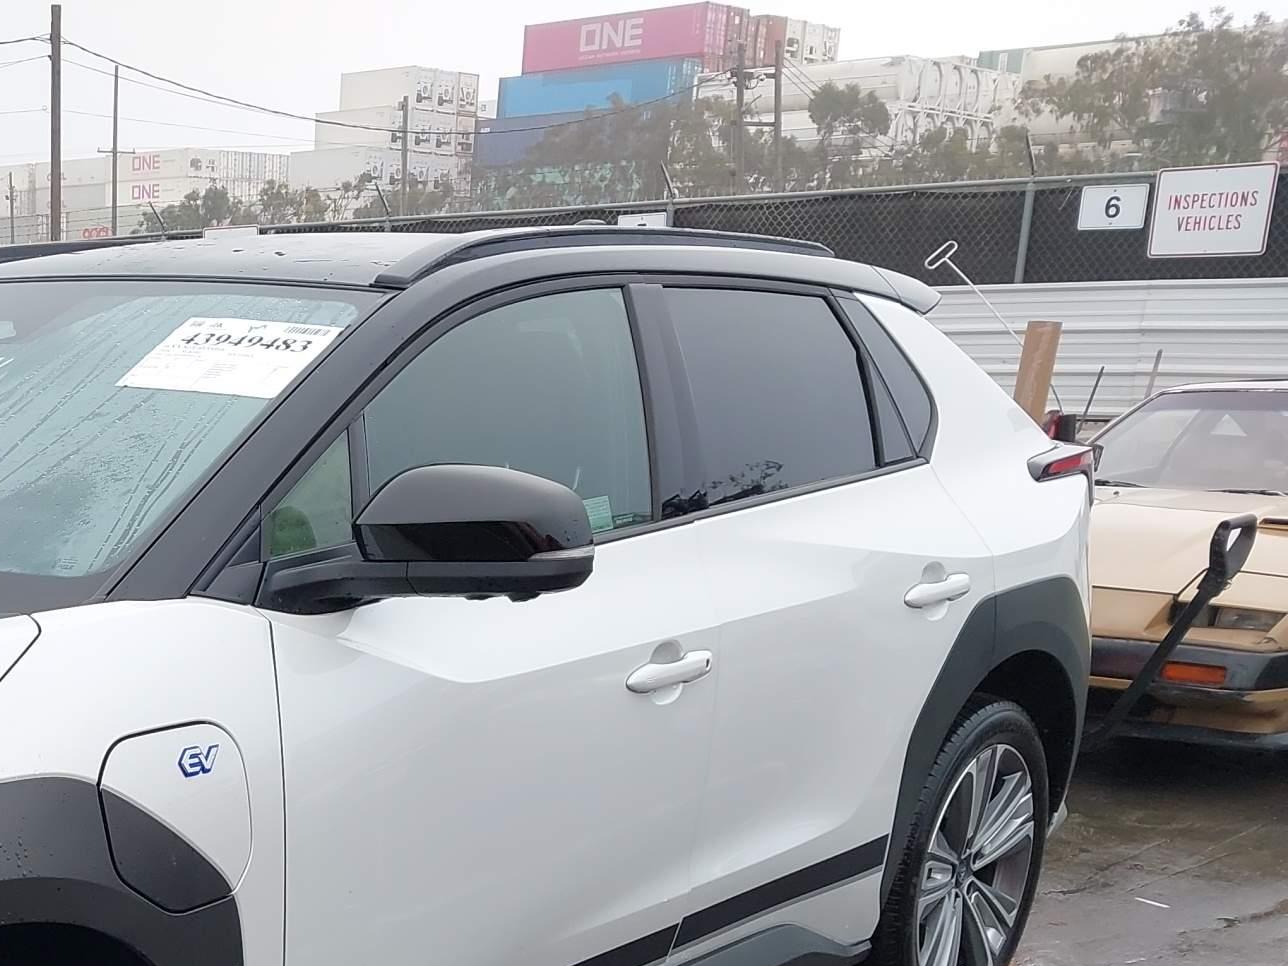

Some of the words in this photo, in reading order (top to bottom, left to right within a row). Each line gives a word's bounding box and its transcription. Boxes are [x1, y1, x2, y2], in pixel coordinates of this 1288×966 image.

[579, 17, 644, 52] ONE
[132, 154, 161, 171] ONE
[132, 184, 160, 200] ONE
[1167, 190, 1260, 211] INSPECTIONS
[1104, 195, 1121, 218] 6
[1177, 214, 1243, 233] VEHICLES
[181, 332, 313, 353] 43949483
[178, 744, 219, 778] EV
